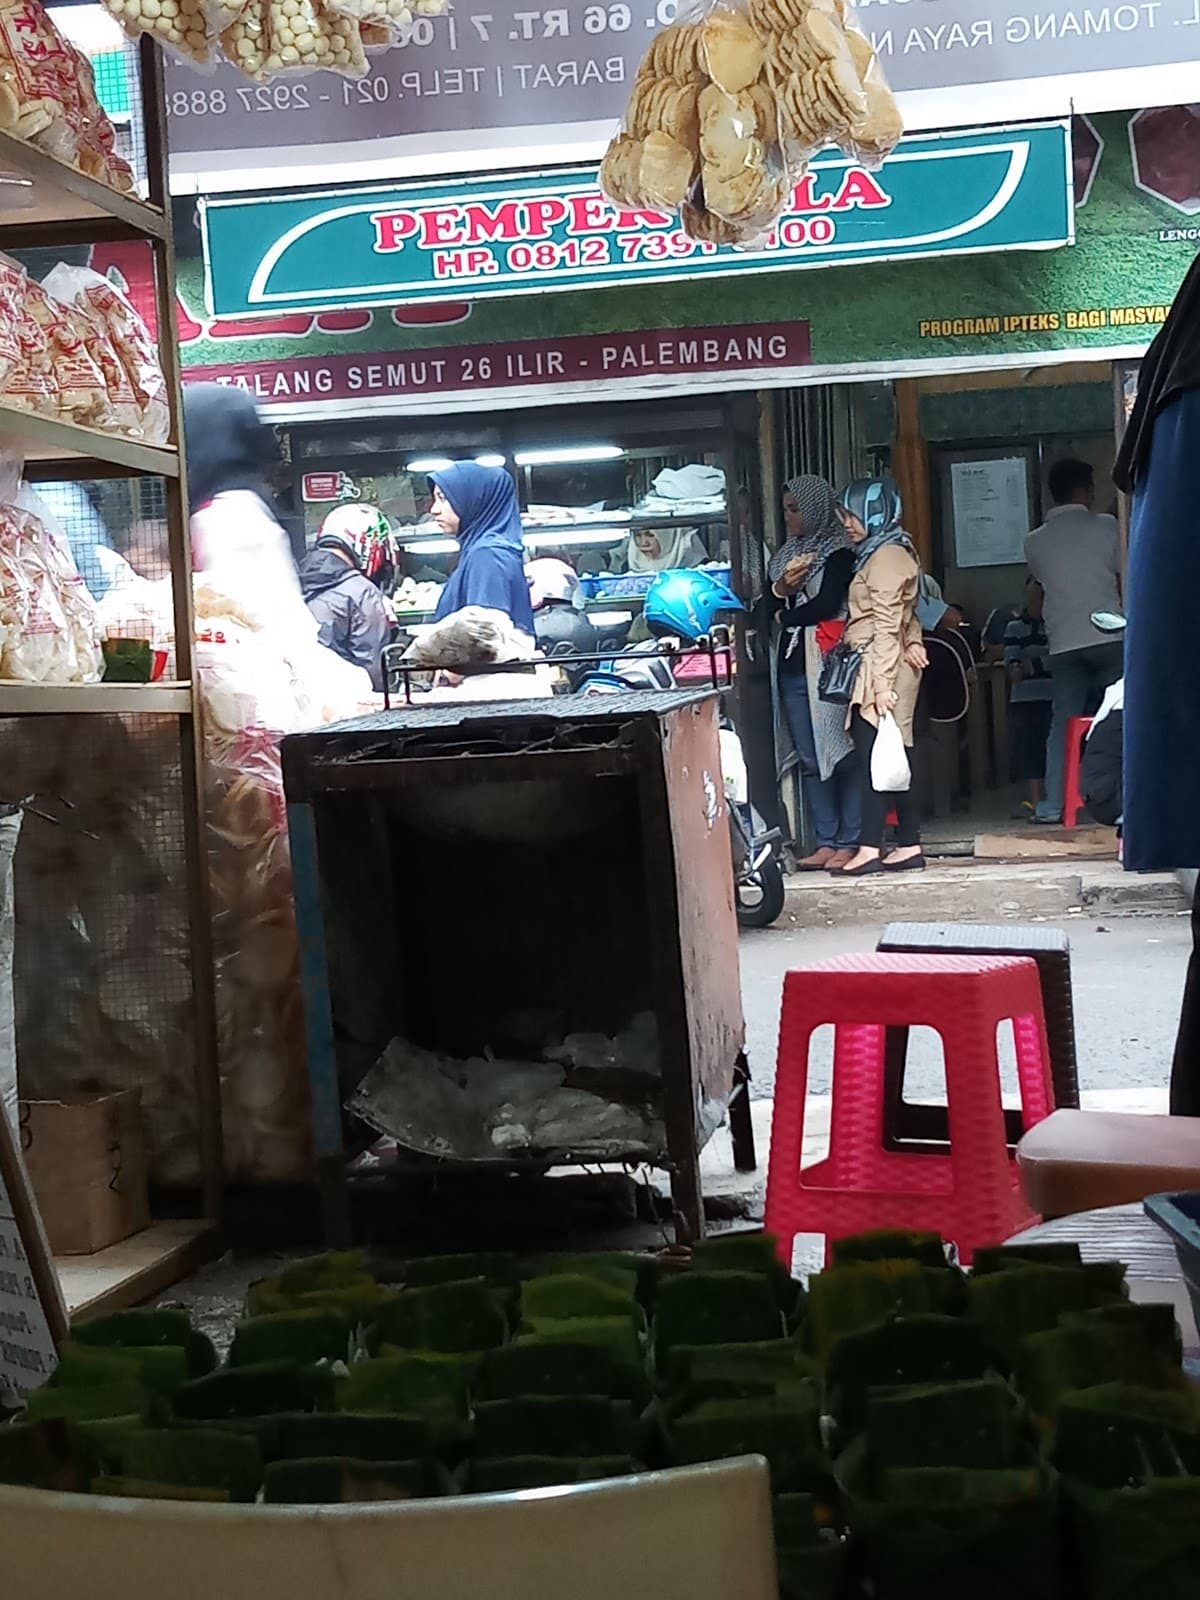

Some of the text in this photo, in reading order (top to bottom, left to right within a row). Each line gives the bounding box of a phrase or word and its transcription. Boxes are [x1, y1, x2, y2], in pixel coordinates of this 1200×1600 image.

[782, 170, 888, 212] LA
[437, 250, 495, 275] HP.
[510, 240, 606, 268] 0812
[620, 232, 713, 259] 739
[1159, 229, 1200, 241] LENG
[920, 317, 1000, 338] PROGRAM
[1003, 313, 1060, 333] IPTEKS
[1066, 310, 1106, 329] BAGI
[347, 359, 447, 390] SEMUT
[460, 358, 493, 382] 26
[506, 351, 565, 378] ILIR
[602, 335, 788, 371] PALEMBANG
